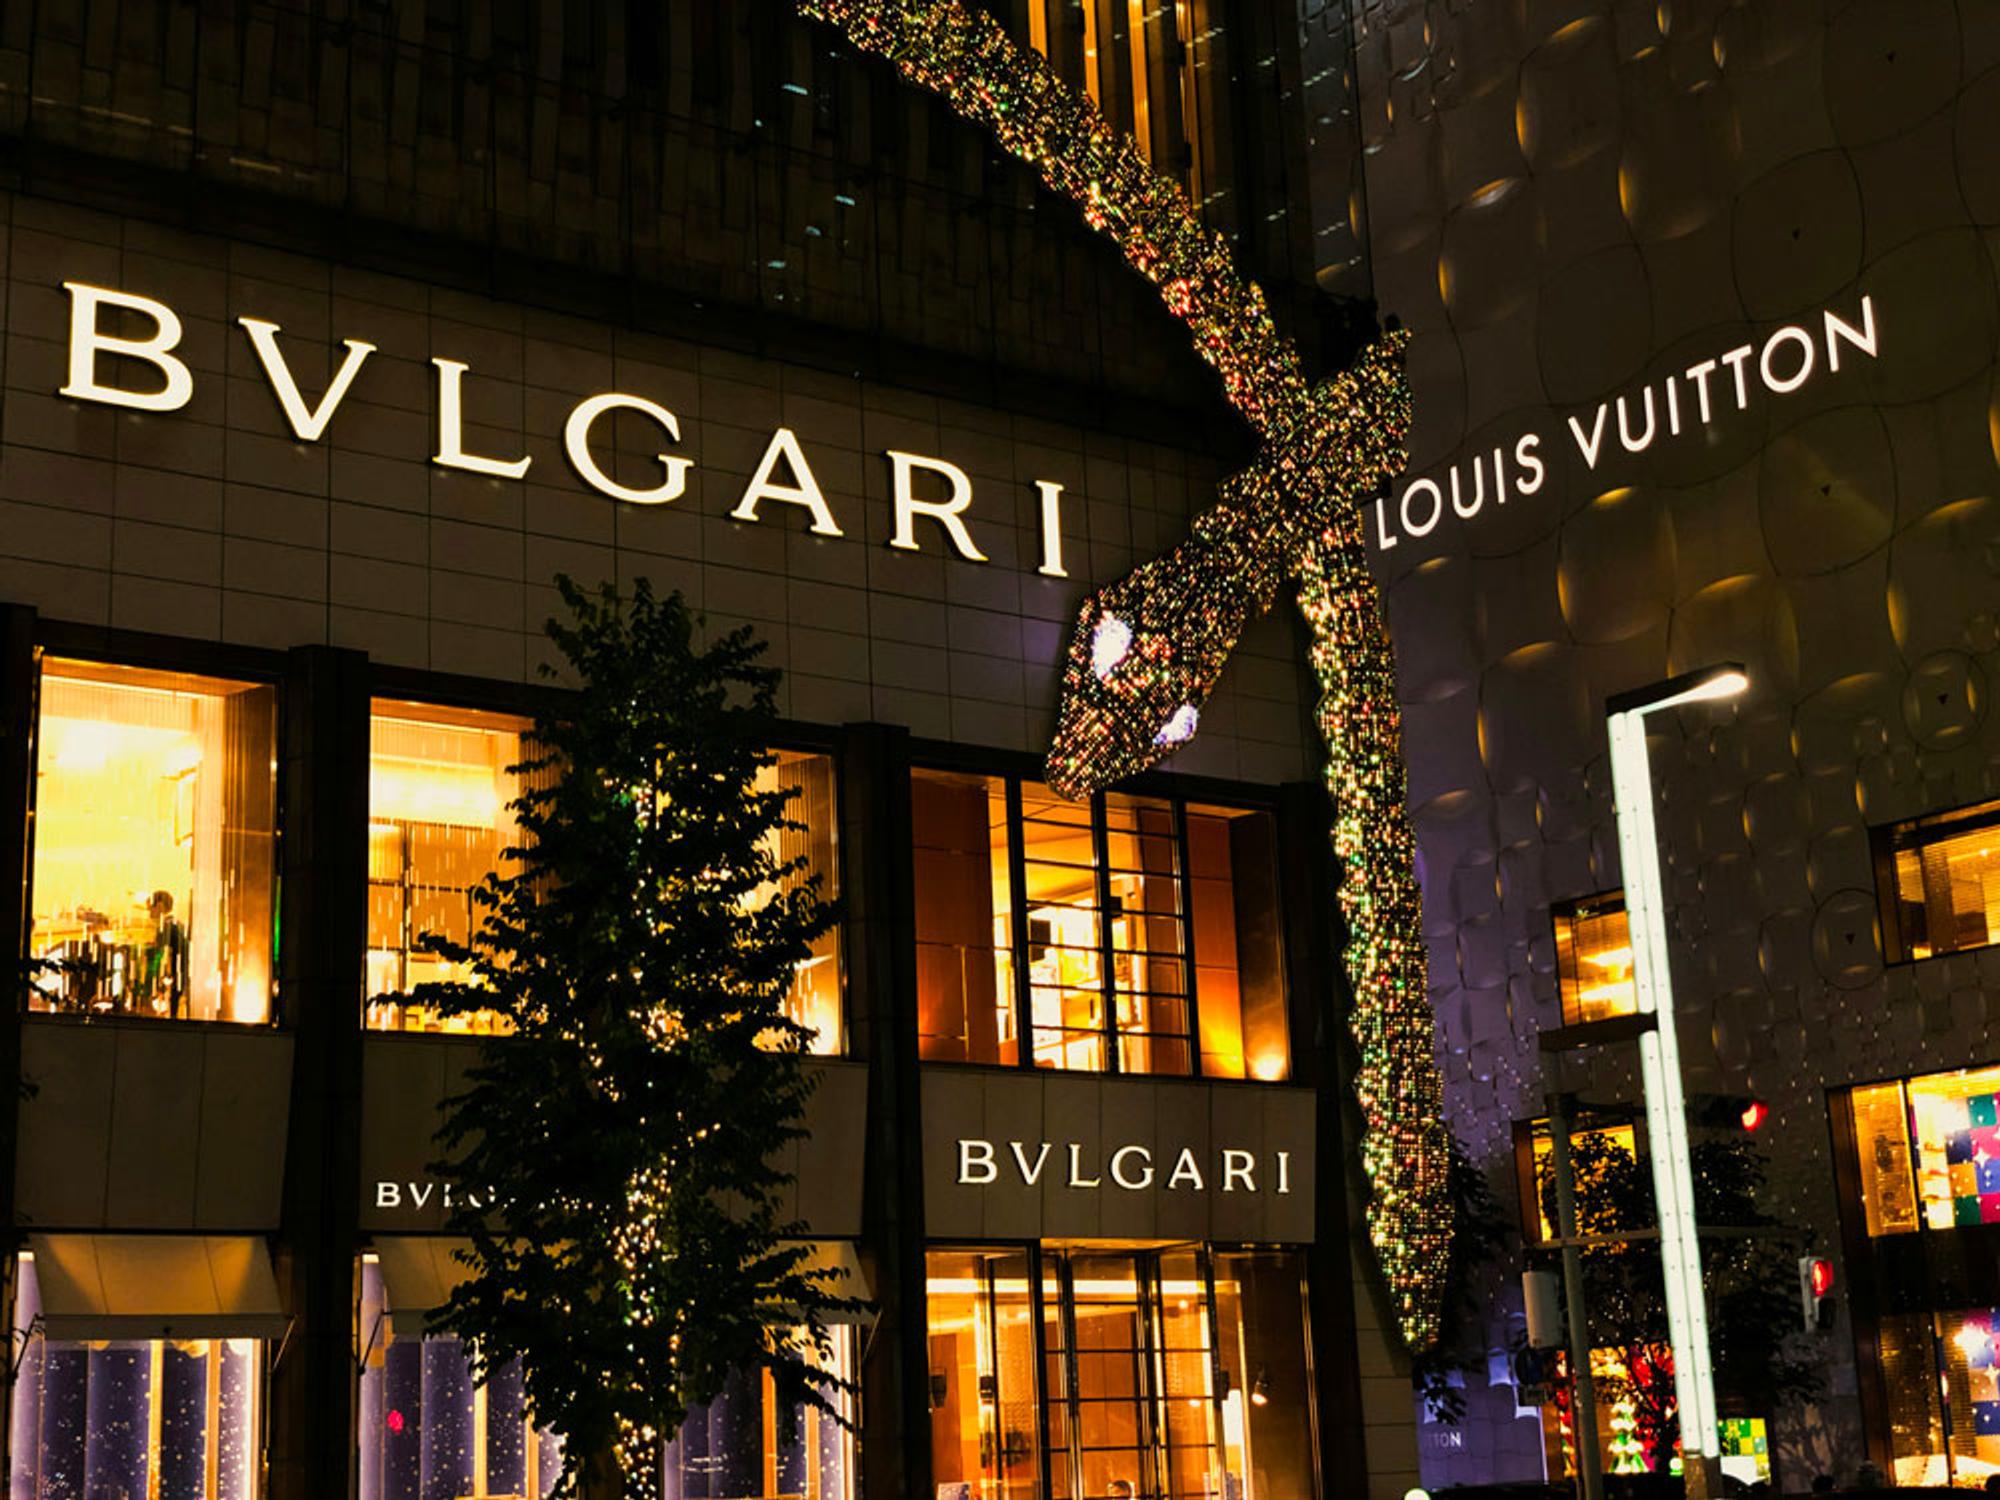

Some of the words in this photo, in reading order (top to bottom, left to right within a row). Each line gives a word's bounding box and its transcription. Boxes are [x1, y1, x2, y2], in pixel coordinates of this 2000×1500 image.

[59, 282, 1069, 578] BVLGARI
[1374, 433, 1545, 552] LOUIS
[1566, 295, 1878, 470] VUITTON
[957, 1139, 1290, 1194] BVLGARI
